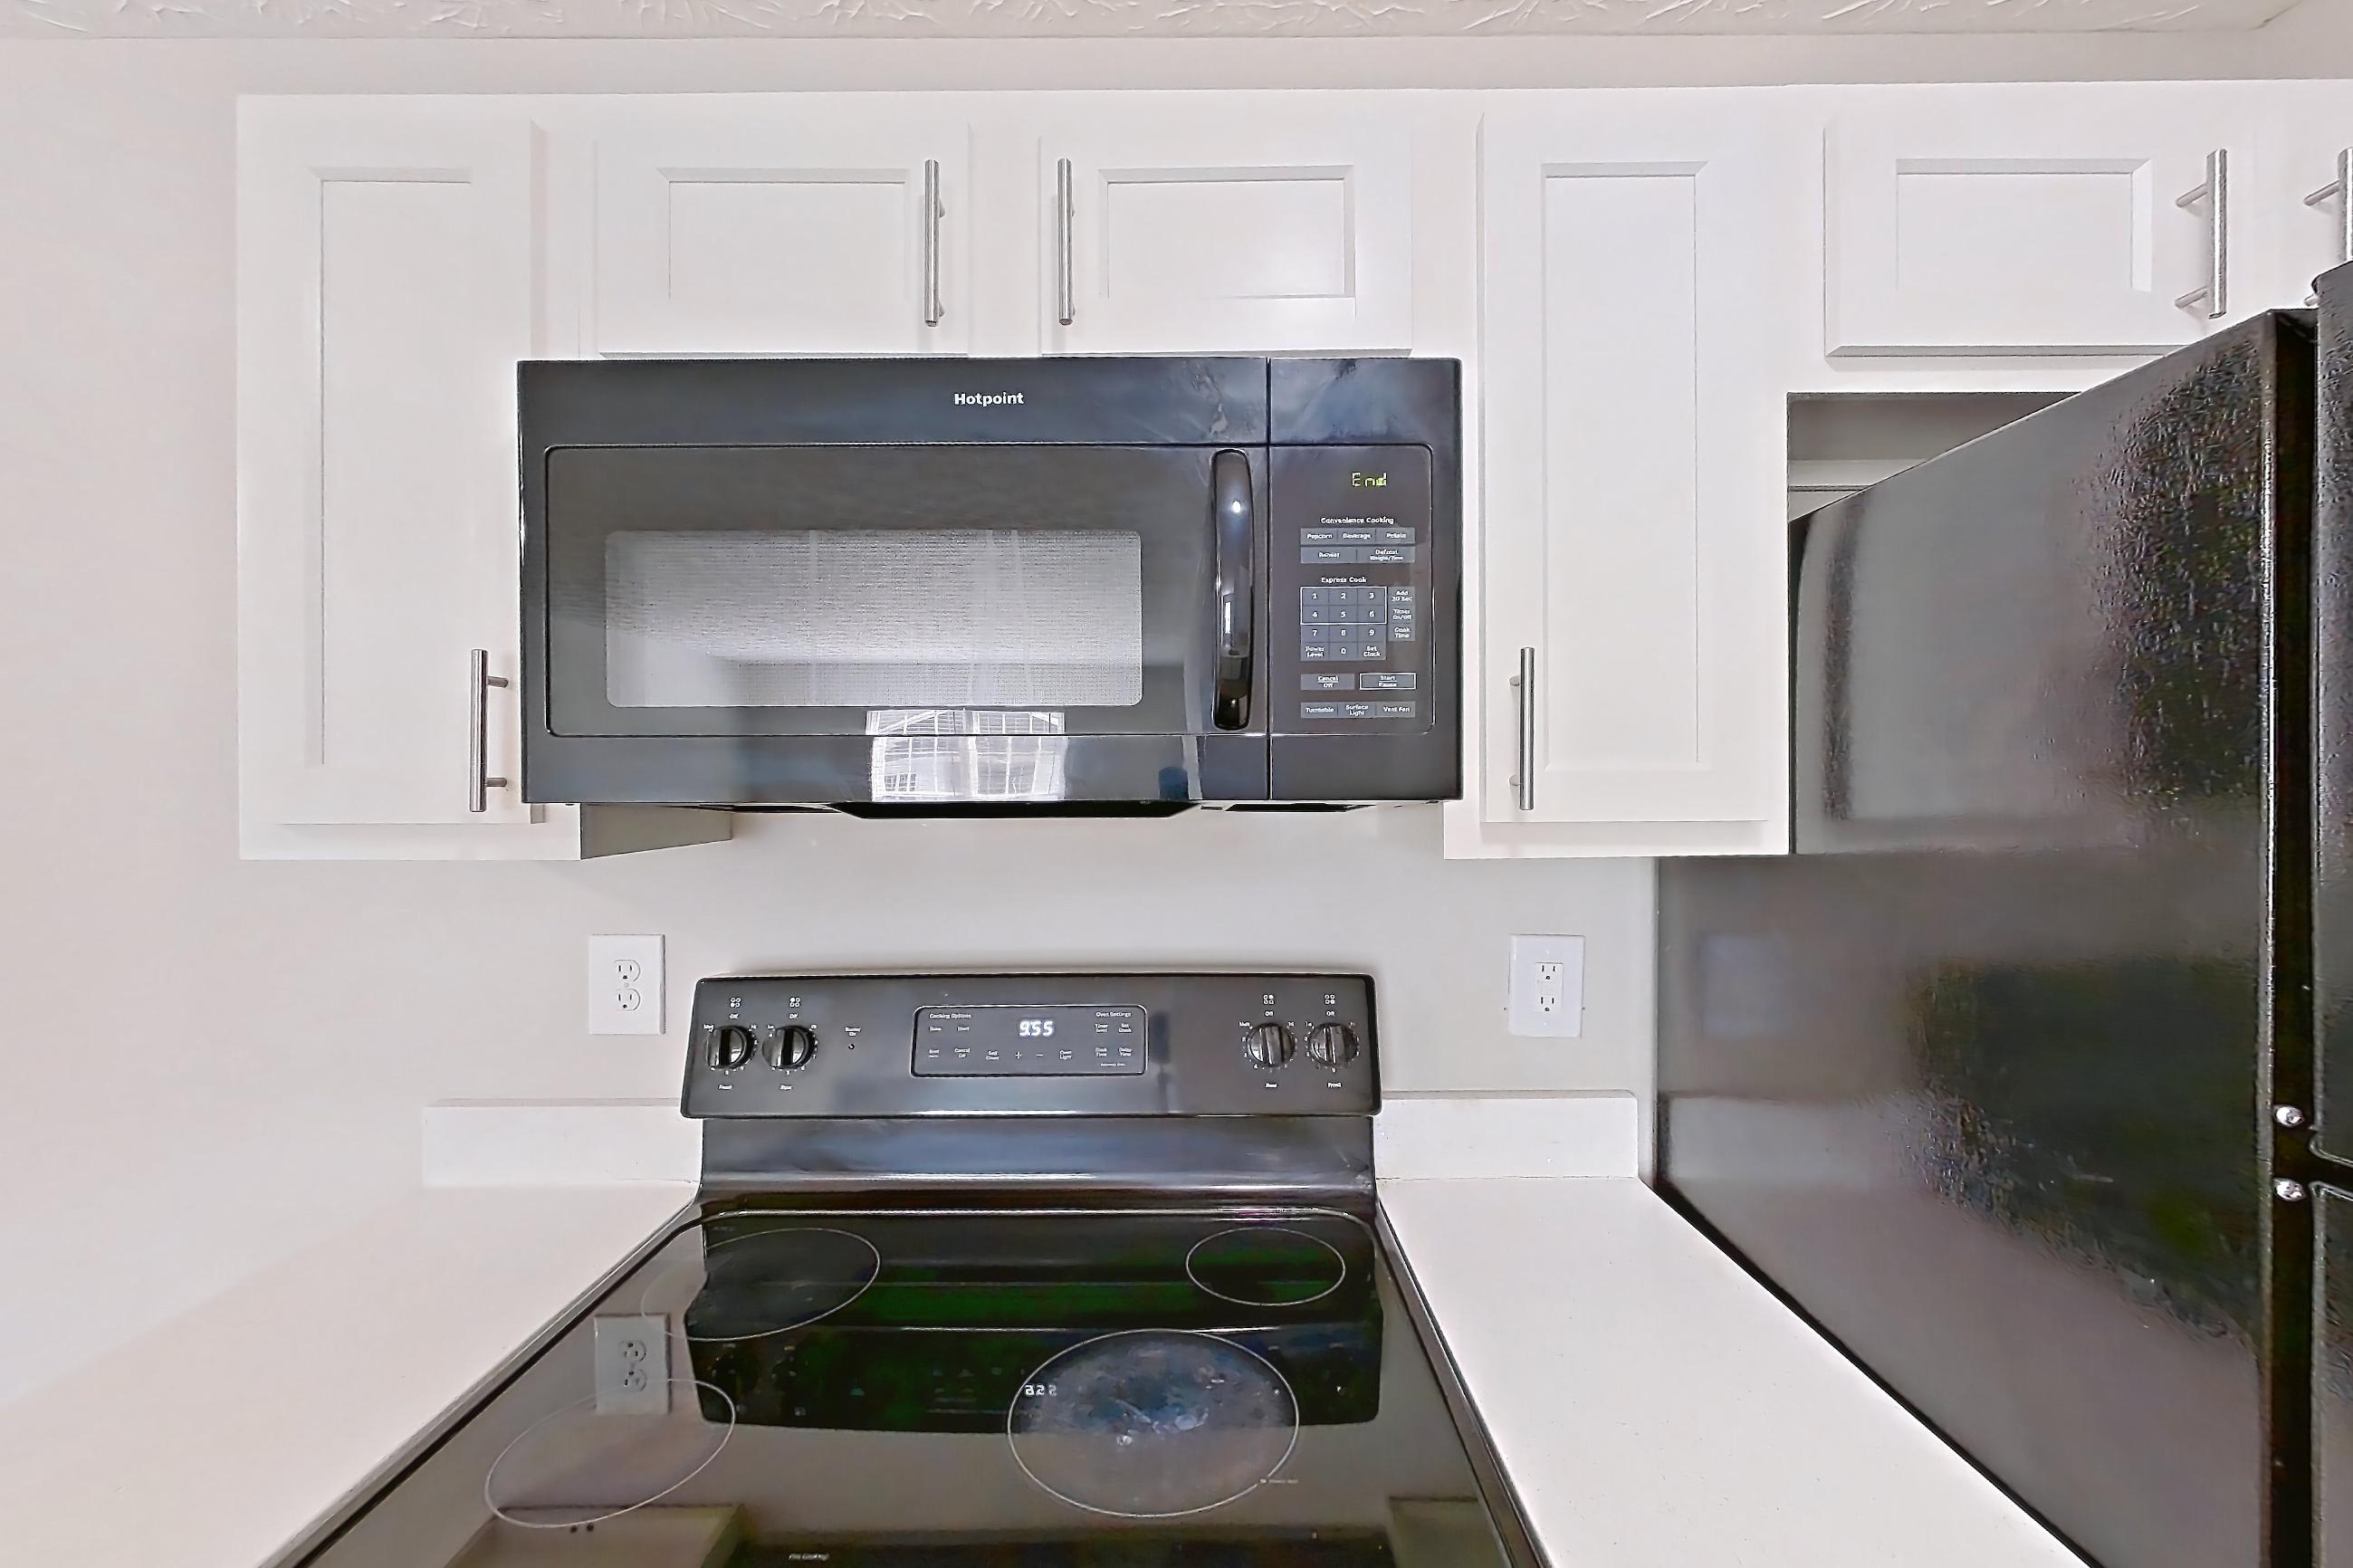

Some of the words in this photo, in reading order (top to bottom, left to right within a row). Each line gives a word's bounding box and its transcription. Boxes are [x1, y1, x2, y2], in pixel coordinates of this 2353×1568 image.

[953, 391, 1025, 407] Hotpoint
[1352, 472, 1387, 487] End
[1365, 516, 1394, 525] Cooking
[1306, 532, 1333, 540] Popcorn
[1343, 532, 1372, 540] Beverage
[1340, 592, 1346, 600] 2
[1368, 628, 1375, 636] 9
